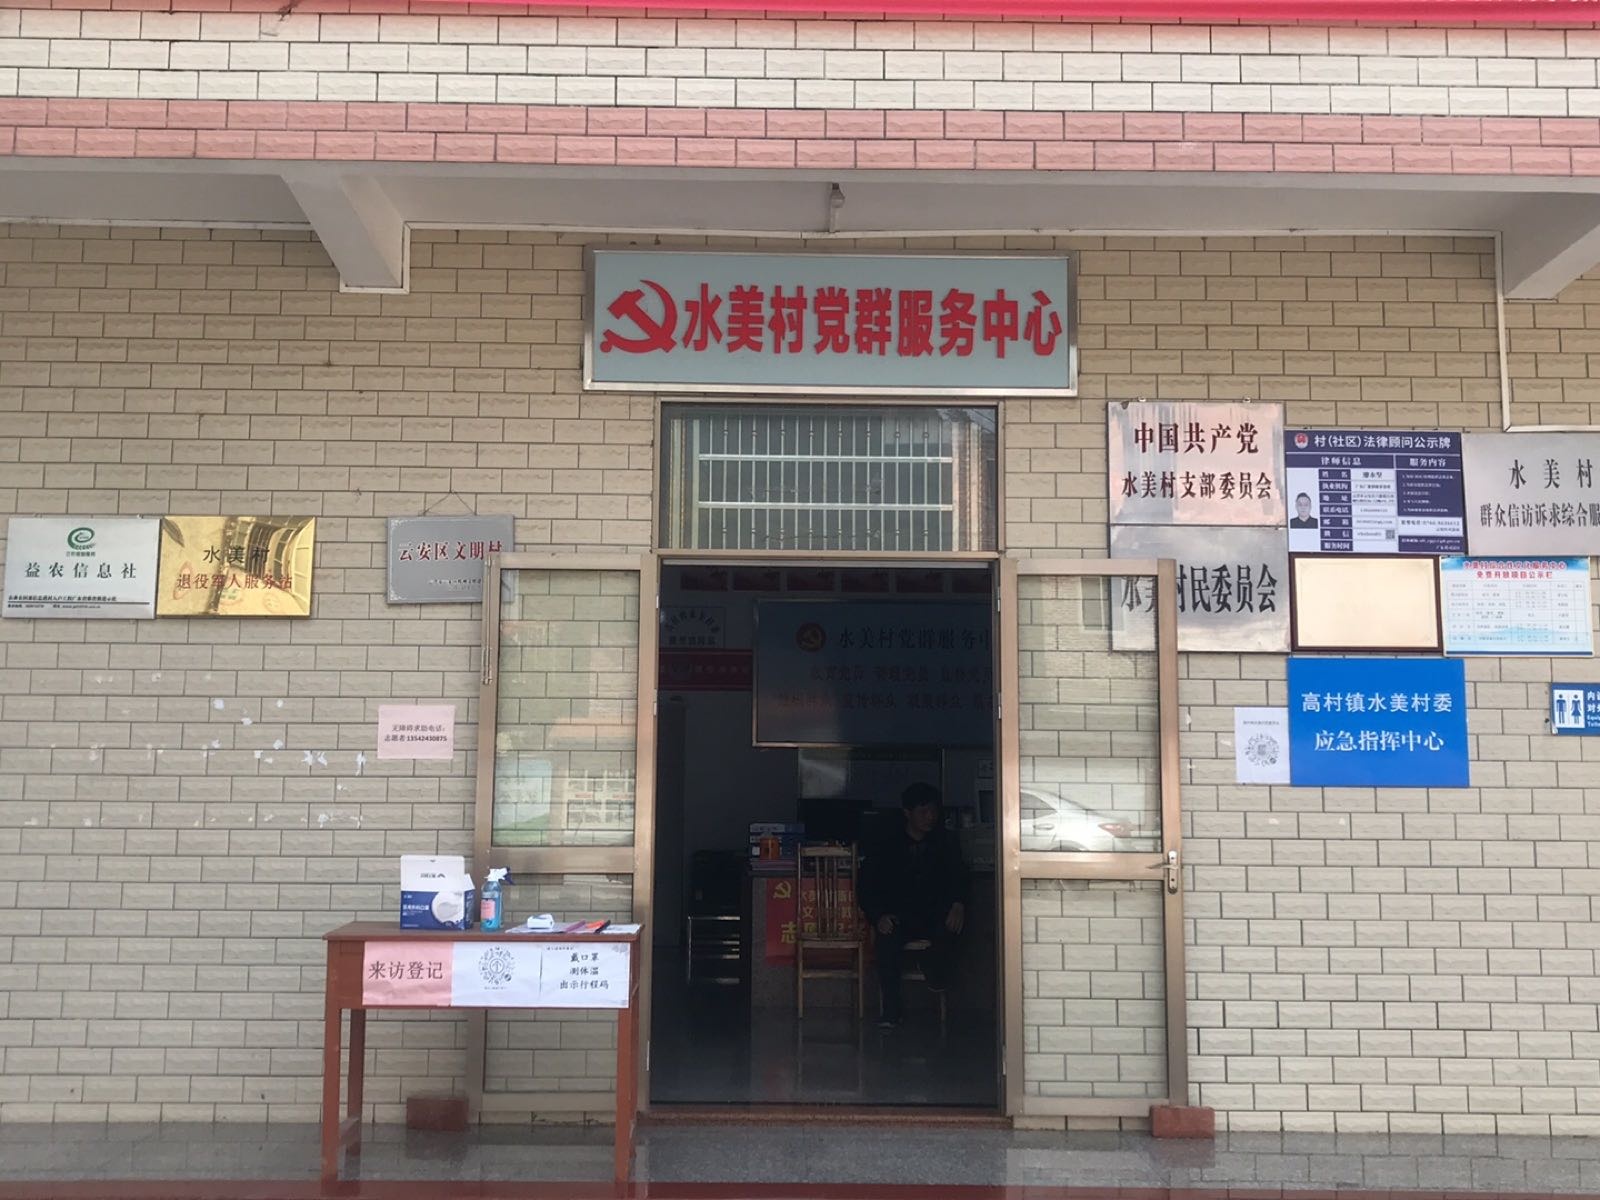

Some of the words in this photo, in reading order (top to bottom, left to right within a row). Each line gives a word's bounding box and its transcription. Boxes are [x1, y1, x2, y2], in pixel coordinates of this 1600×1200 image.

[682, 283, 1063, 358] 水美村党群服务中心
[1134, 421, 1260, 454] 中国共产党
[1314, 435, 1451, 449] 村(社区)法律顾问公示牌
[1409, 457, 1446, 467] 服务内容
[1508, 459, 1593, 489] 水美村
[1122, 471, 1272, 500] 水美村支部委员会
[203, 545, 270, 564] 水美村
[25, 562, 137, 579] 益农信息社
[177, 573, 293, 590] 退役军人服务站
[1121, 563, 1278, 613] 水村民委员会
[1301, 692, 1452, 713] 高村镇水美村委
[1314, 730, 1444, 752] 应急指挥中心
[570, 952, 600, 962] 戴口罩
[368, 960, 444, 981] 来访登记
[569, 966, 599, 976] 测体温
[560, 980, 609, 990] 出示行程码
